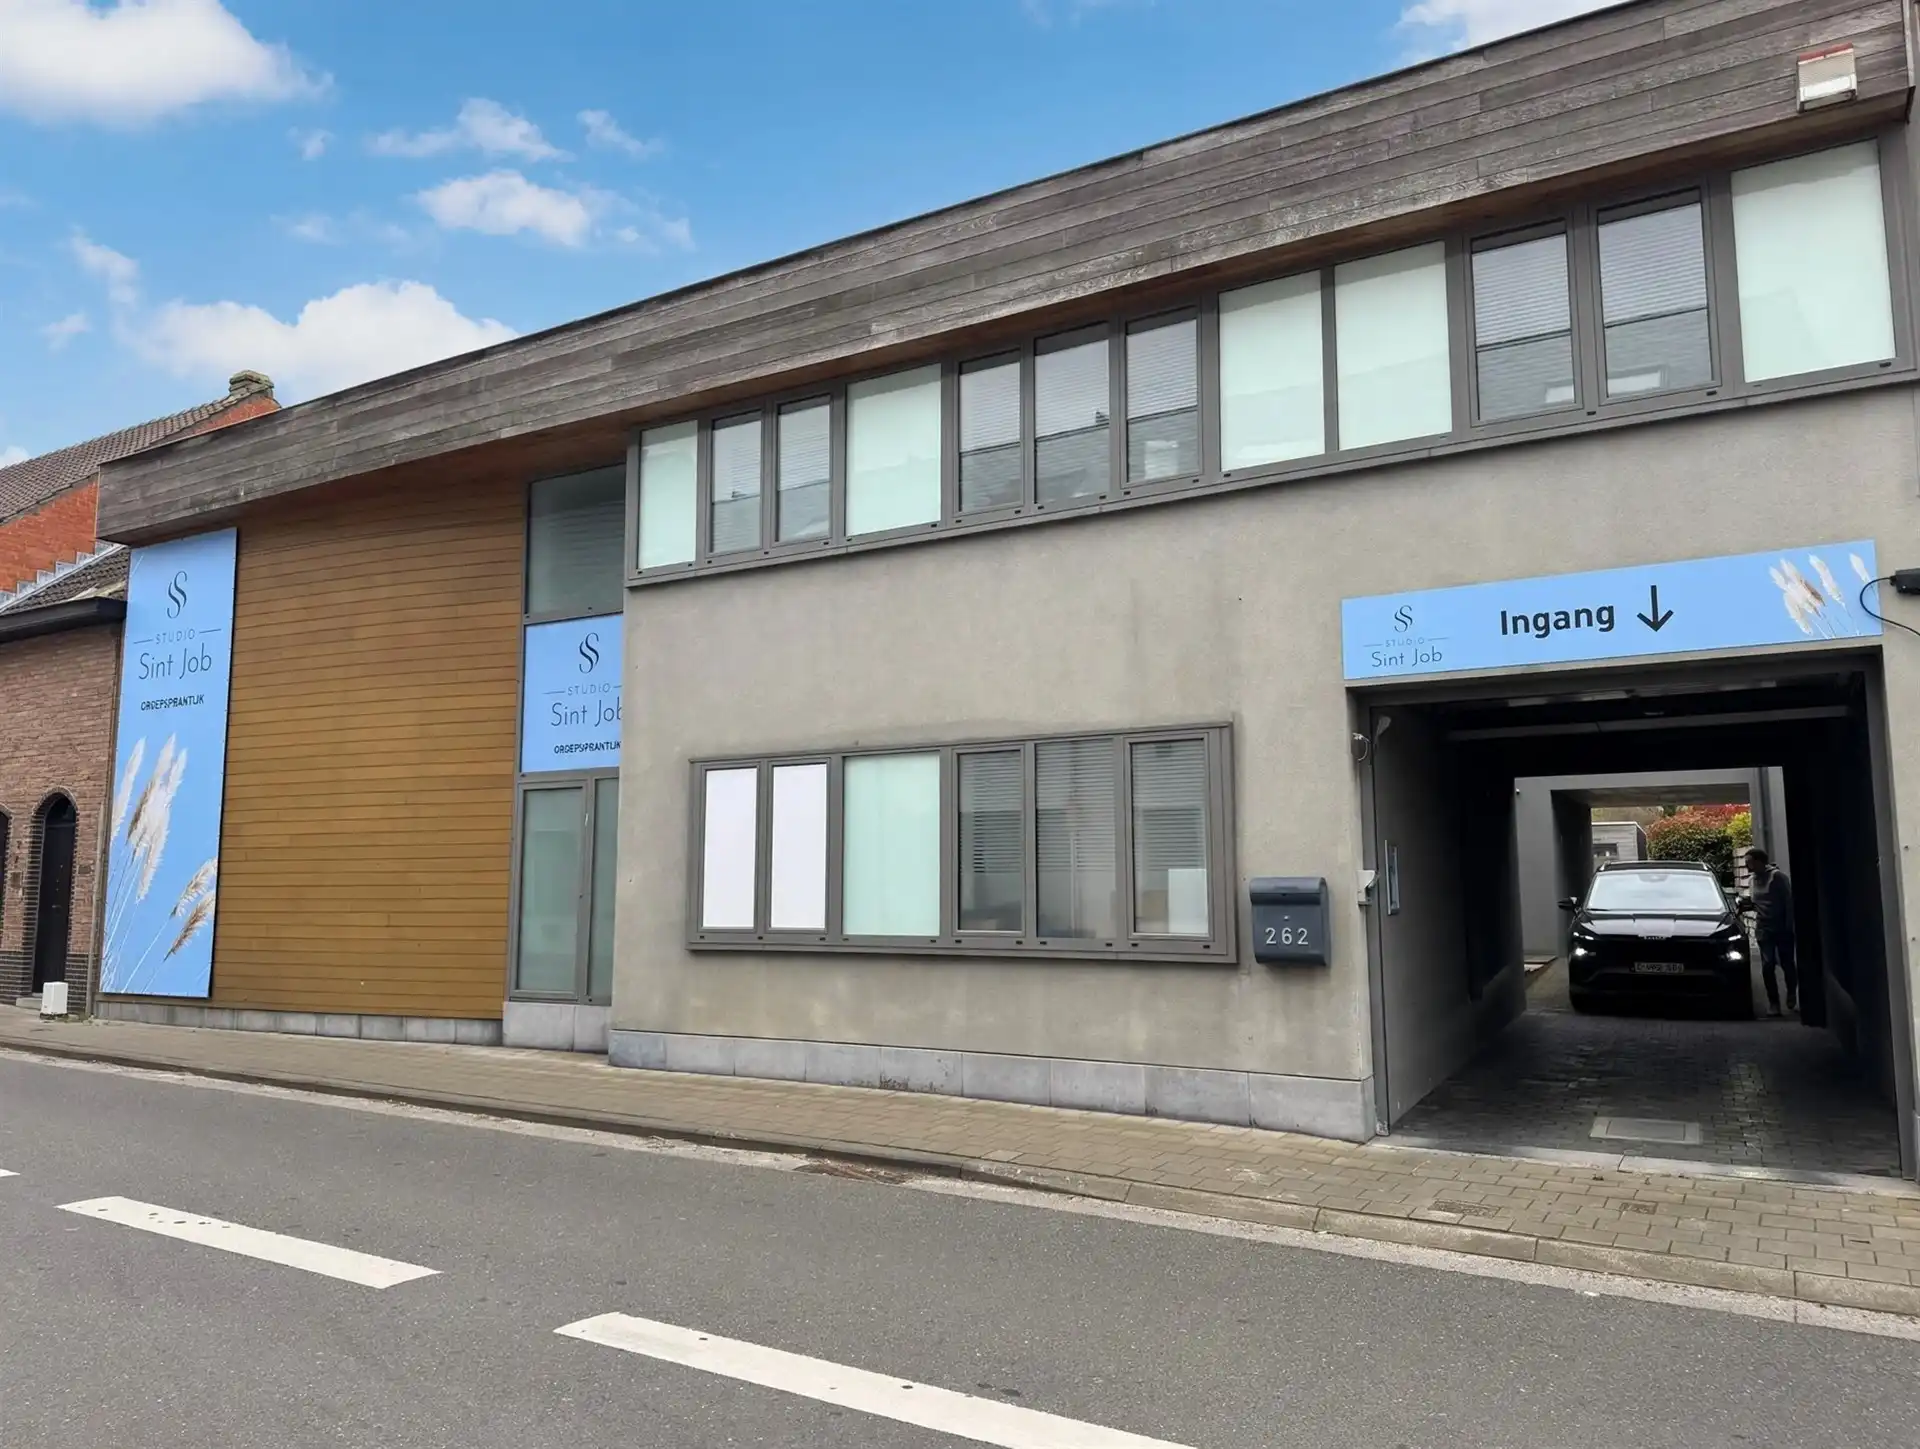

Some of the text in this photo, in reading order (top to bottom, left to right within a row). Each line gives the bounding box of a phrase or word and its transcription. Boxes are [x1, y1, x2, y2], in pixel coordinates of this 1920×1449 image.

[1500, 605, 1615, 639] Ingang
[155, 628, 195, 645] STUDIO
[1385, 636, 1425, 647] STUDIO
[138, 642, 212, 680] Sint Job
[1371, 645, 1443, 667] Sint Job
[567, 682, 611, 696] STUDIO
[550, 702, 587, 727] Sint
[1265, 927, 1309, 945] 262
